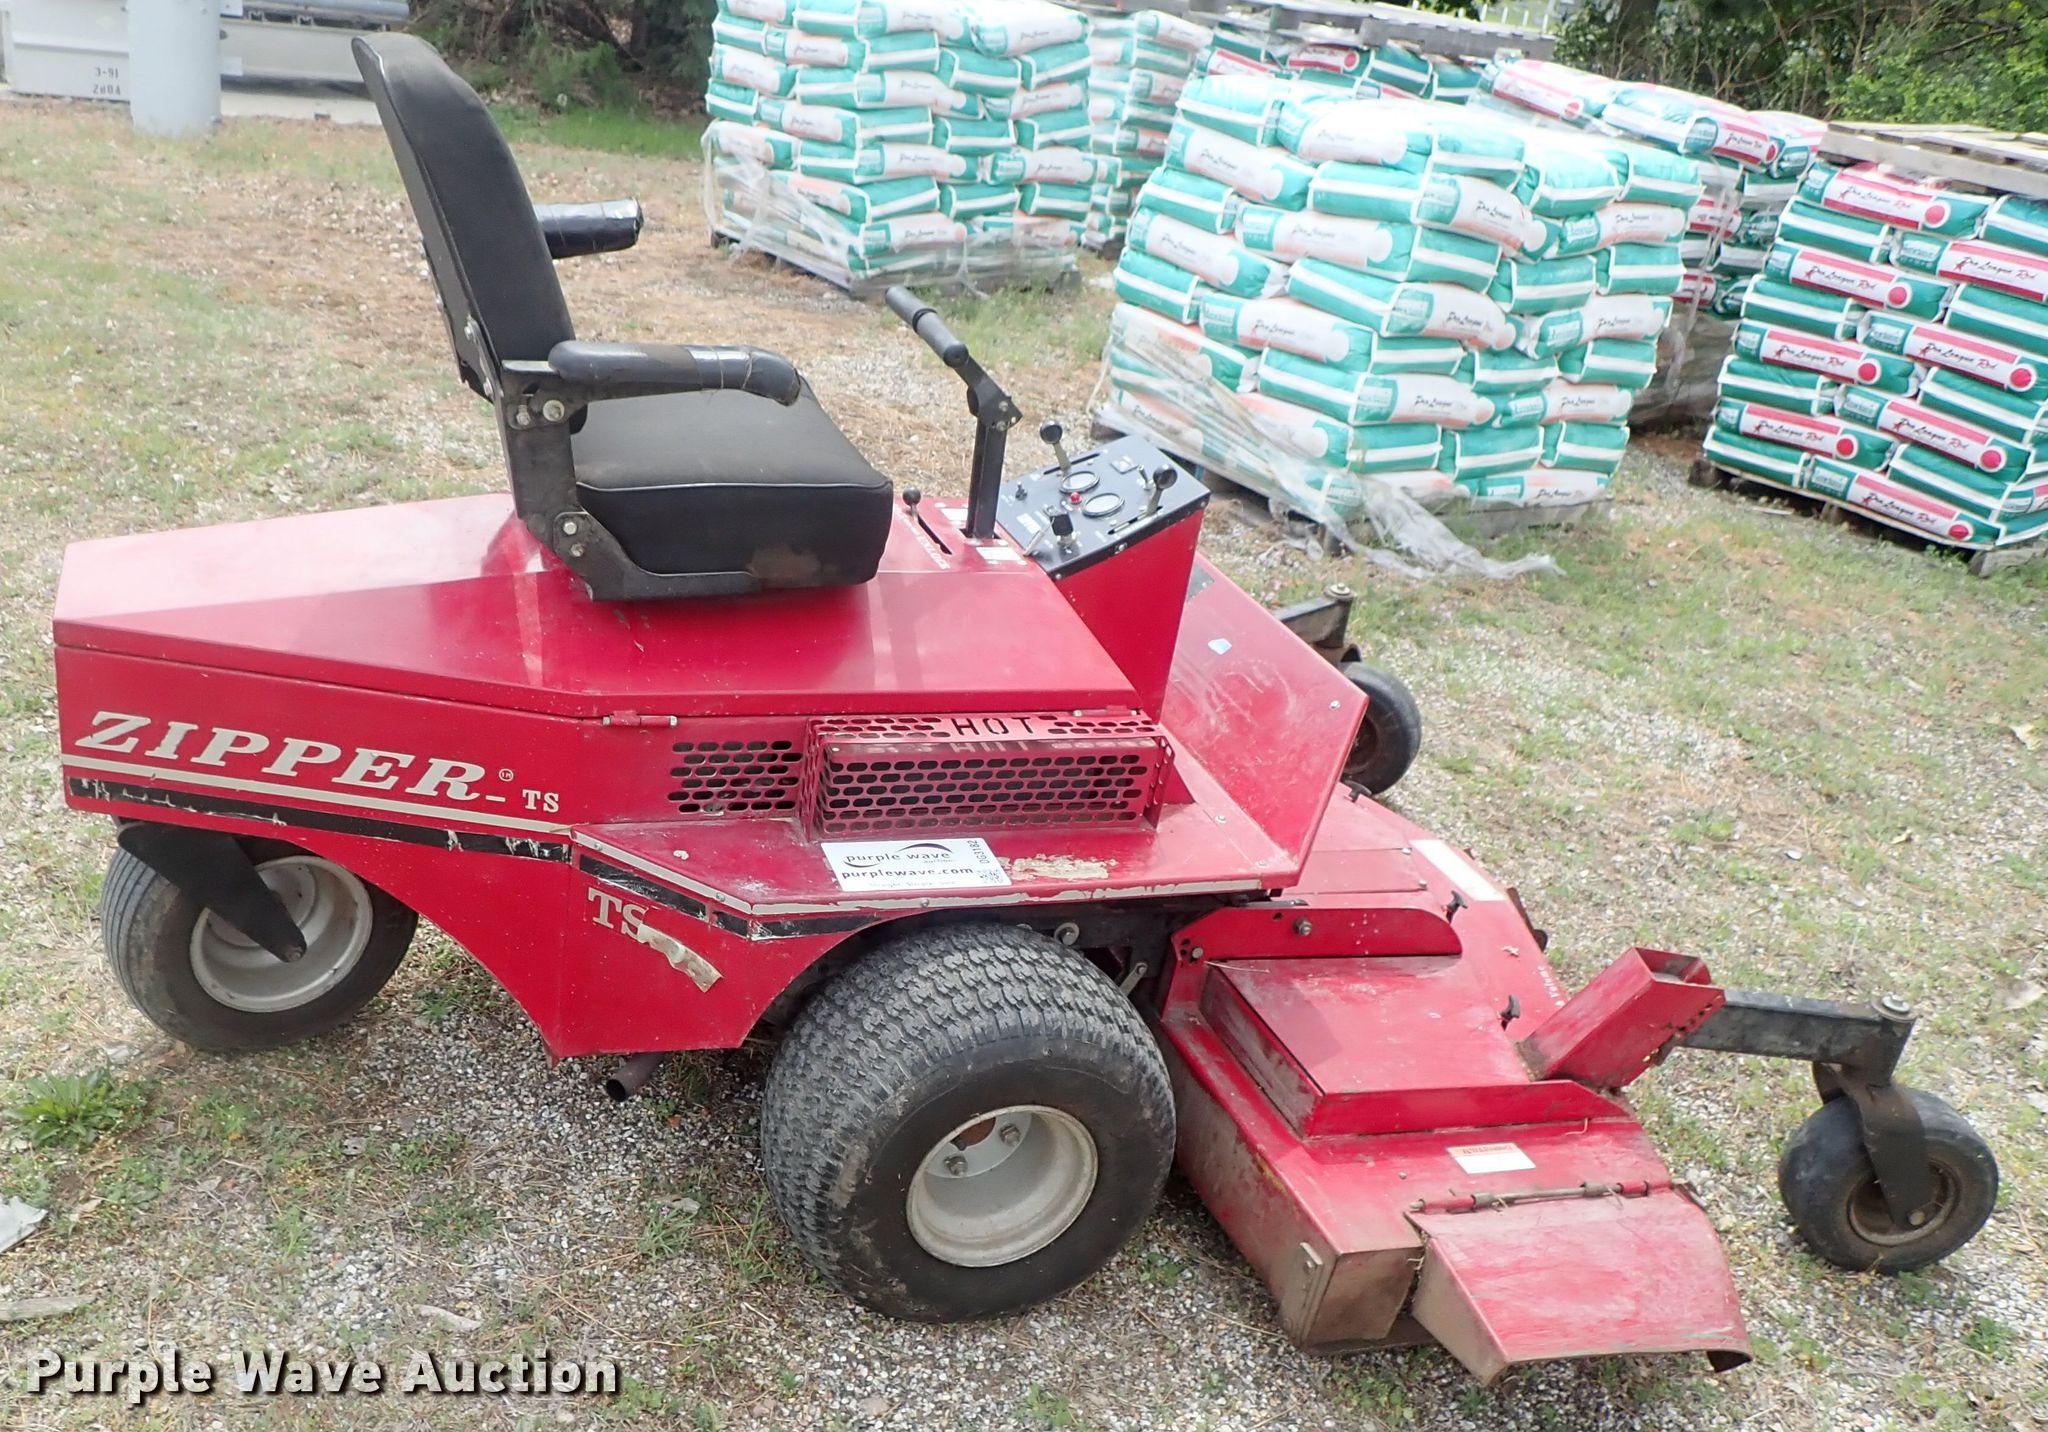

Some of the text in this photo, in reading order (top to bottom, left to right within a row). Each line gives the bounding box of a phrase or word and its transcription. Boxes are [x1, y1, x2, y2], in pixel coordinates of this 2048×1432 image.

[1846, 185, 1862, 197] Pro
[1962, 256, 1979, 268] Pro
[1812, 264, 1825, 279] Pro
[1780, 344, 1797, 358] Pro
[1927, 342, 1941, 356] Pro
[1758, 419, 1774, 433] Pro
[1900, 416, 1915, 430] Pro
[1867, 491, 1883, 505] Pro
[951, 717, 1033, 736] HOT
[75, 711, 486, 801] ZIPPER
[522, 789, 559, 812] TS
[846, 852, 951, 863] purple wave
[841, 867, 974, 879] purplewave.com
[588, 887, 648, 943] TS
